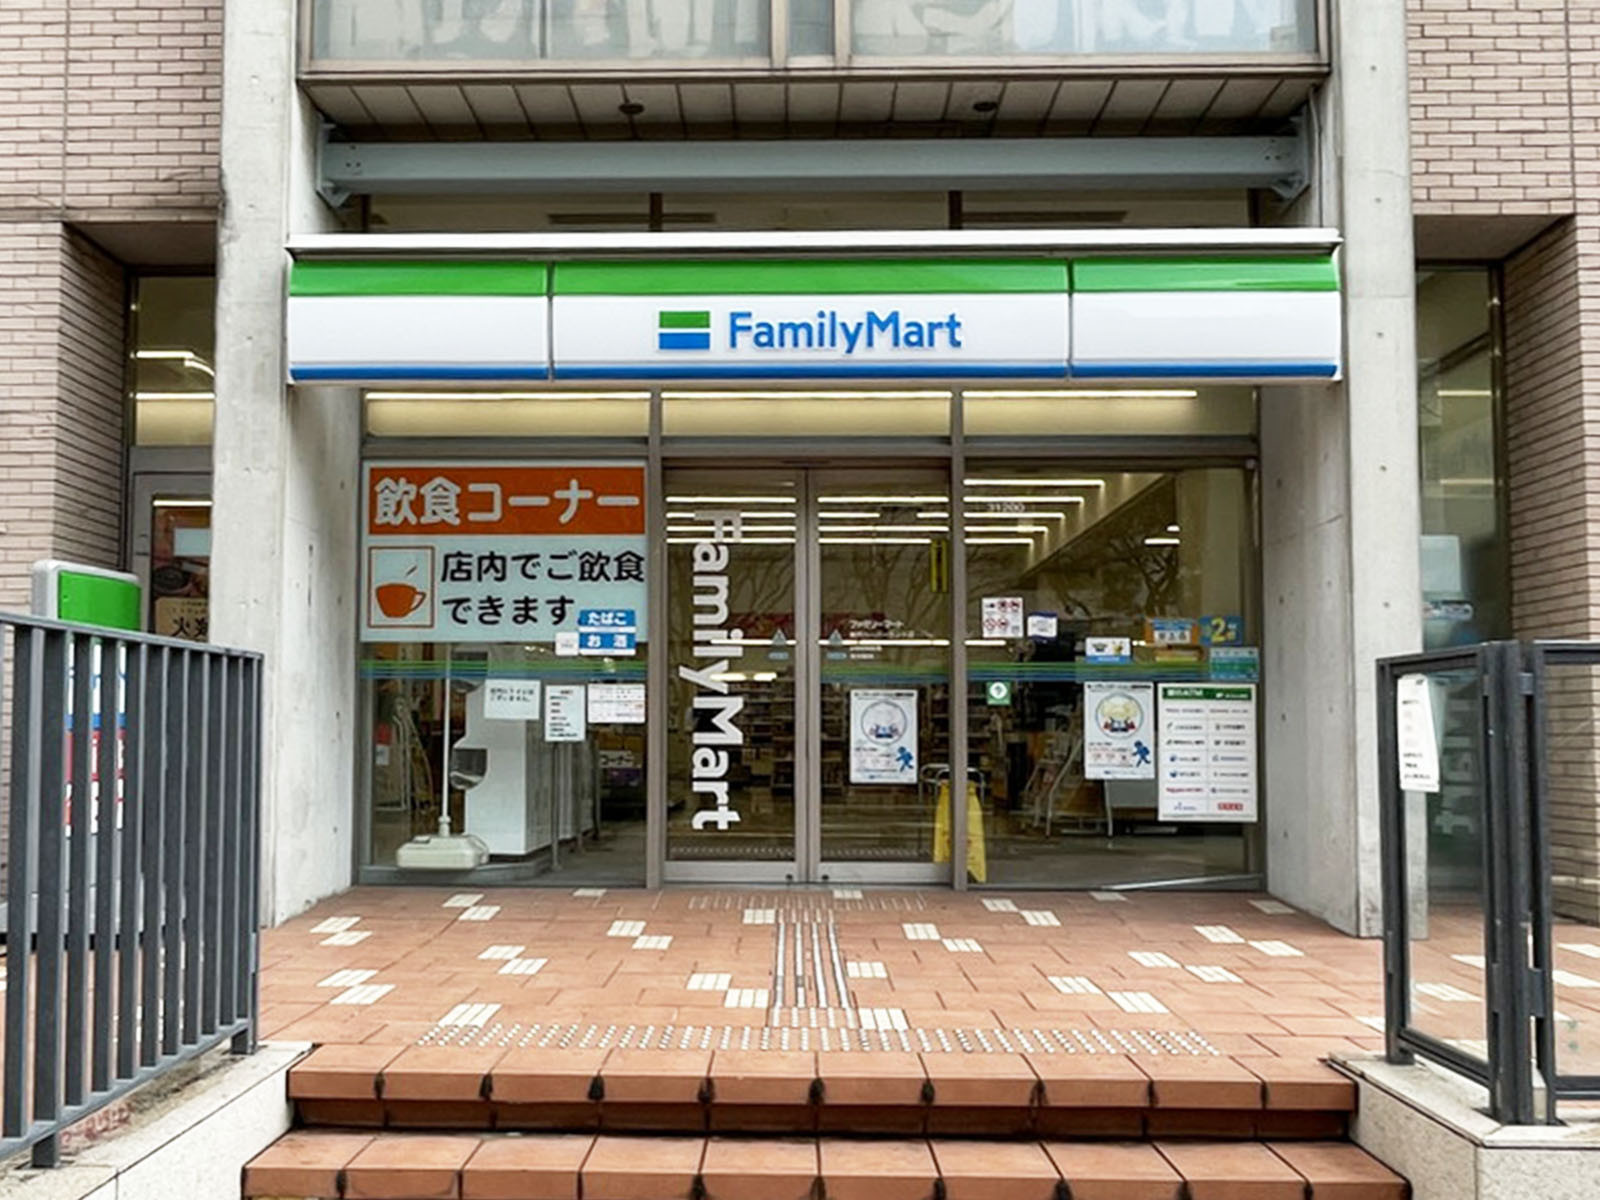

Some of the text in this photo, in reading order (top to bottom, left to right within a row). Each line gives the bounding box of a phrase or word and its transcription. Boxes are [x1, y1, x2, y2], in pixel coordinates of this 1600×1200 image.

[729, 310, 962, 354] FamilyMart
[374, 476, 641, 526] 飲食コーナー
[440, 549, 646, 583] 店内でご飲食
[441, 595, 575, 626] できます
[587, 612, 628, 626] たばこ
[678, 510, 743, 830] FamilyMart
